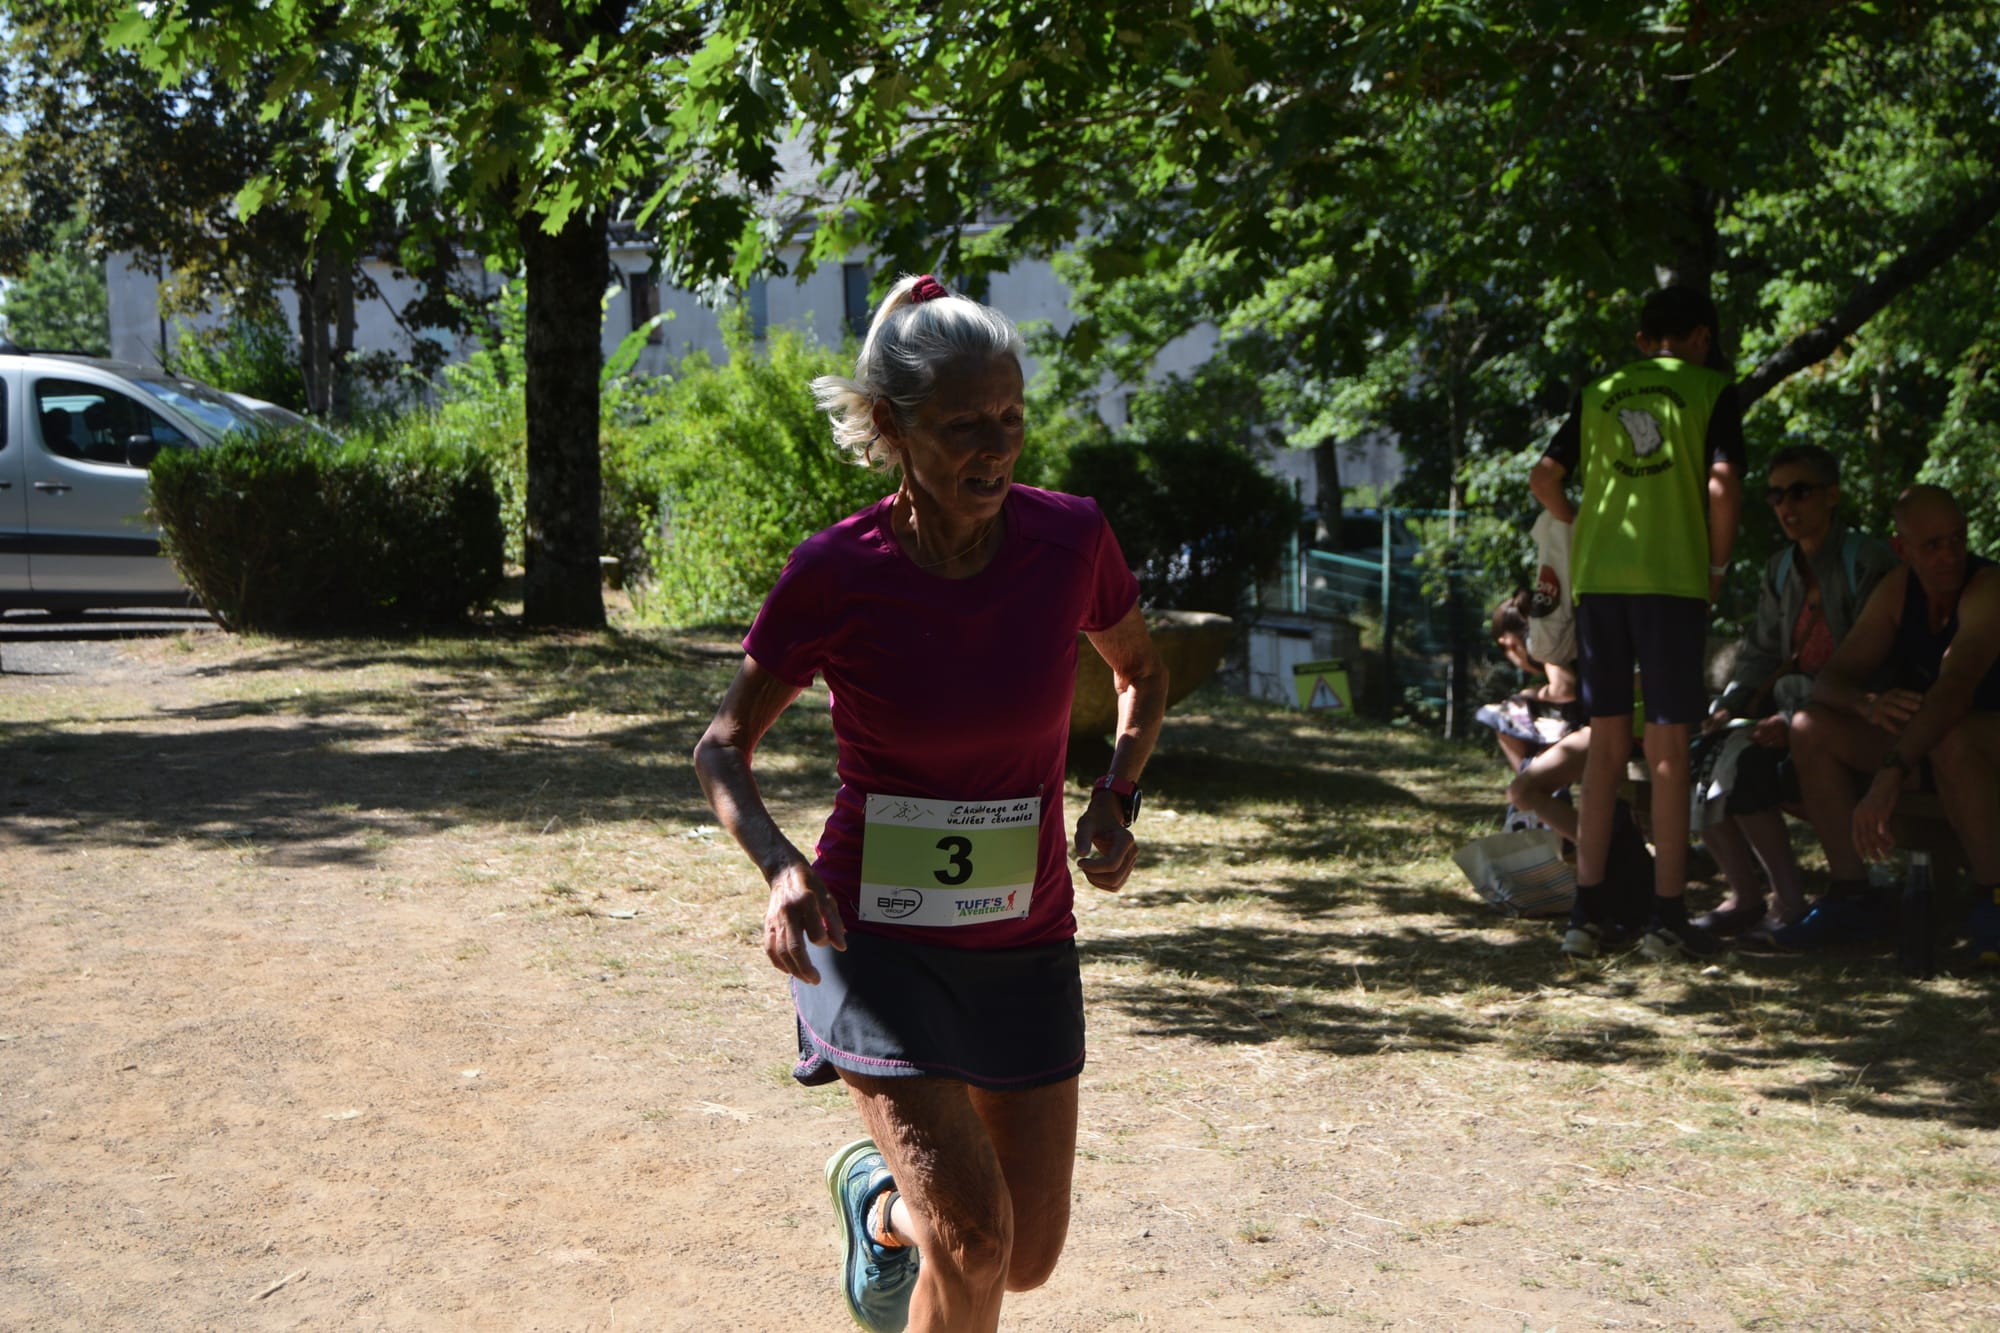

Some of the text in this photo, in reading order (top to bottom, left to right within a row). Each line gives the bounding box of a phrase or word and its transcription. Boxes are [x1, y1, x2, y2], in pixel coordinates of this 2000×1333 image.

[953, 803, 1028, 816] Challenge des
[947, 813, 1032, 824] vallées cévenoles
[933, 835, 973, 885] 3
[877, 897, 916, 909] BFP
[955, 897, 1003, 910] TUFF'S
[958, 905, 1006, 917] Aventure
